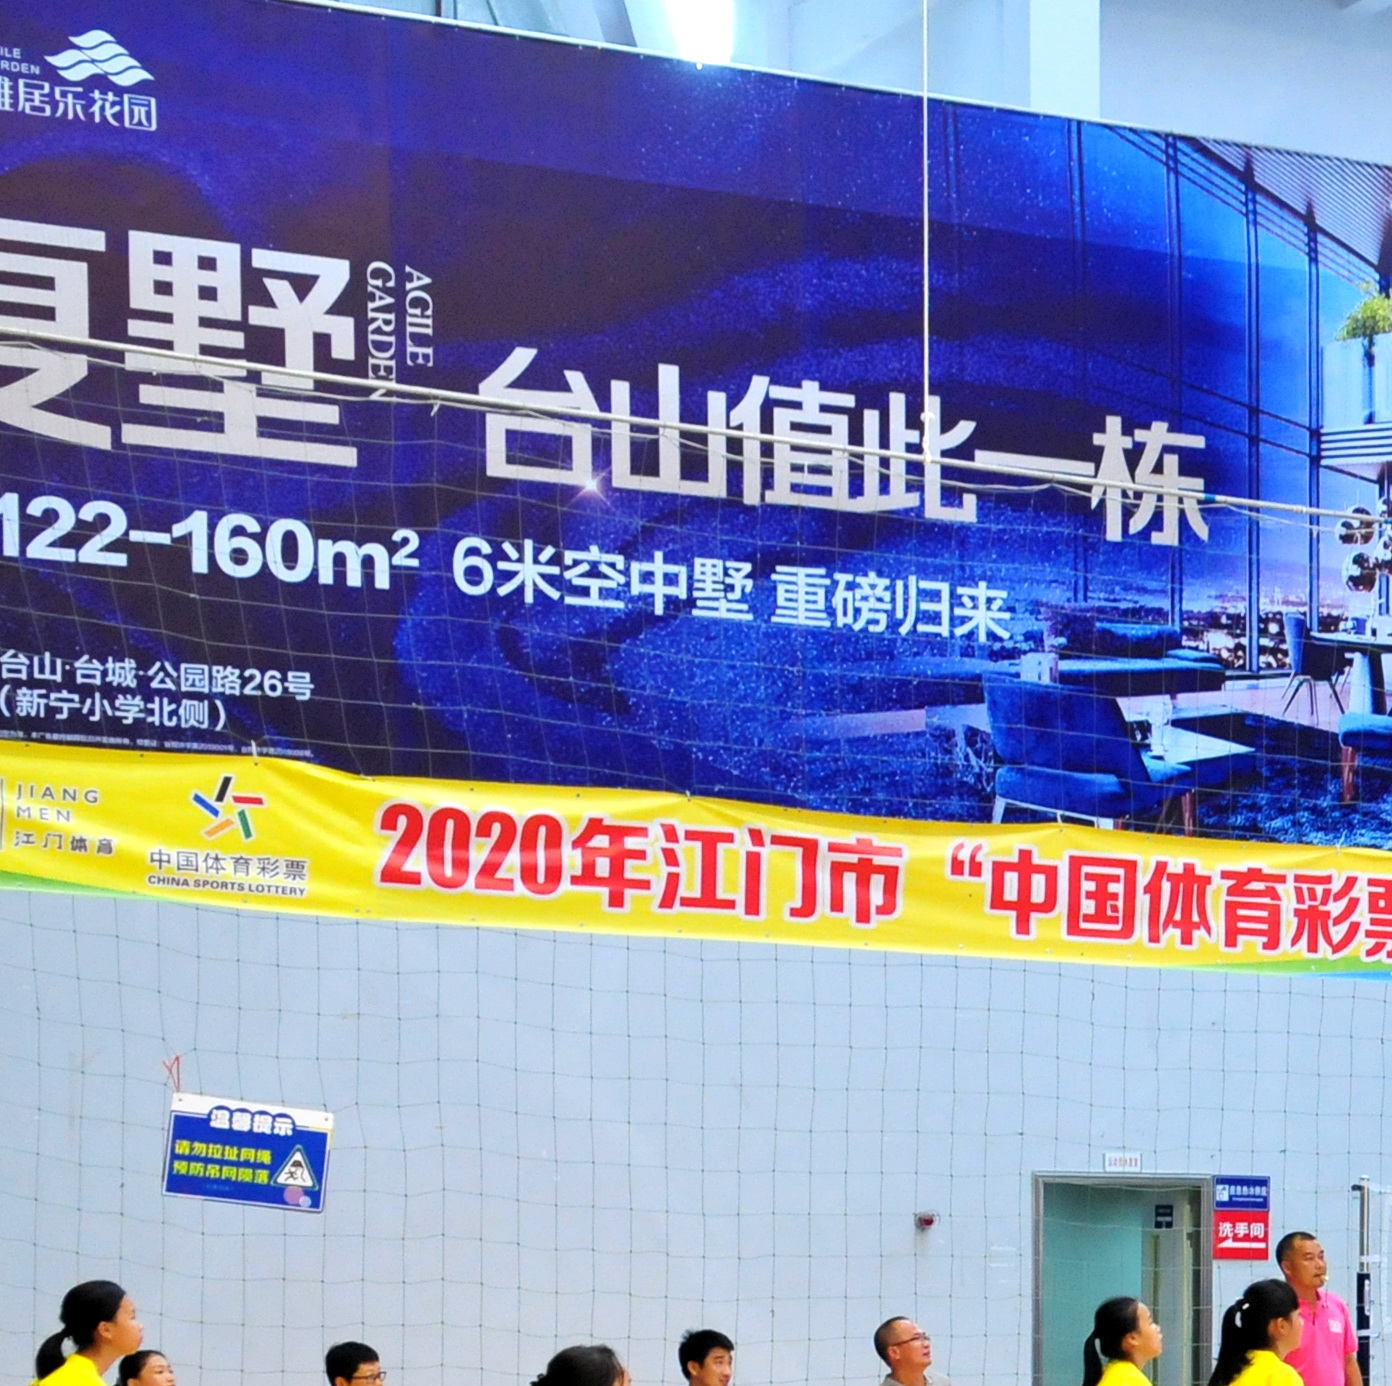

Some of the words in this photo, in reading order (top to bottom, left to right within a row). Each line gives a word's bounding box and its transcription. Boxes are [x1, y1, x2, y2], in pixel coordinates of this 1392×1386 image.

[405, 264, 433, 367] AGILE
[478, 345, 1209, 546] 台山值此一栋
[452, 536, 754, 623] 6米空中墅
[770, 563, 1012, 644] 重磅归来
[16, 783, 99, 804] JIANG
[16, 806, 71, 822] MEN
[149, 848, 308, 881] 中国体育彩票
[148, 874, 191, 888] CHINA
[194, 878, 245, 893] SPORTS
[248, 883, 306, 897] LOTTERY
[1218, 1222, 1265, 1239] 洗手间
